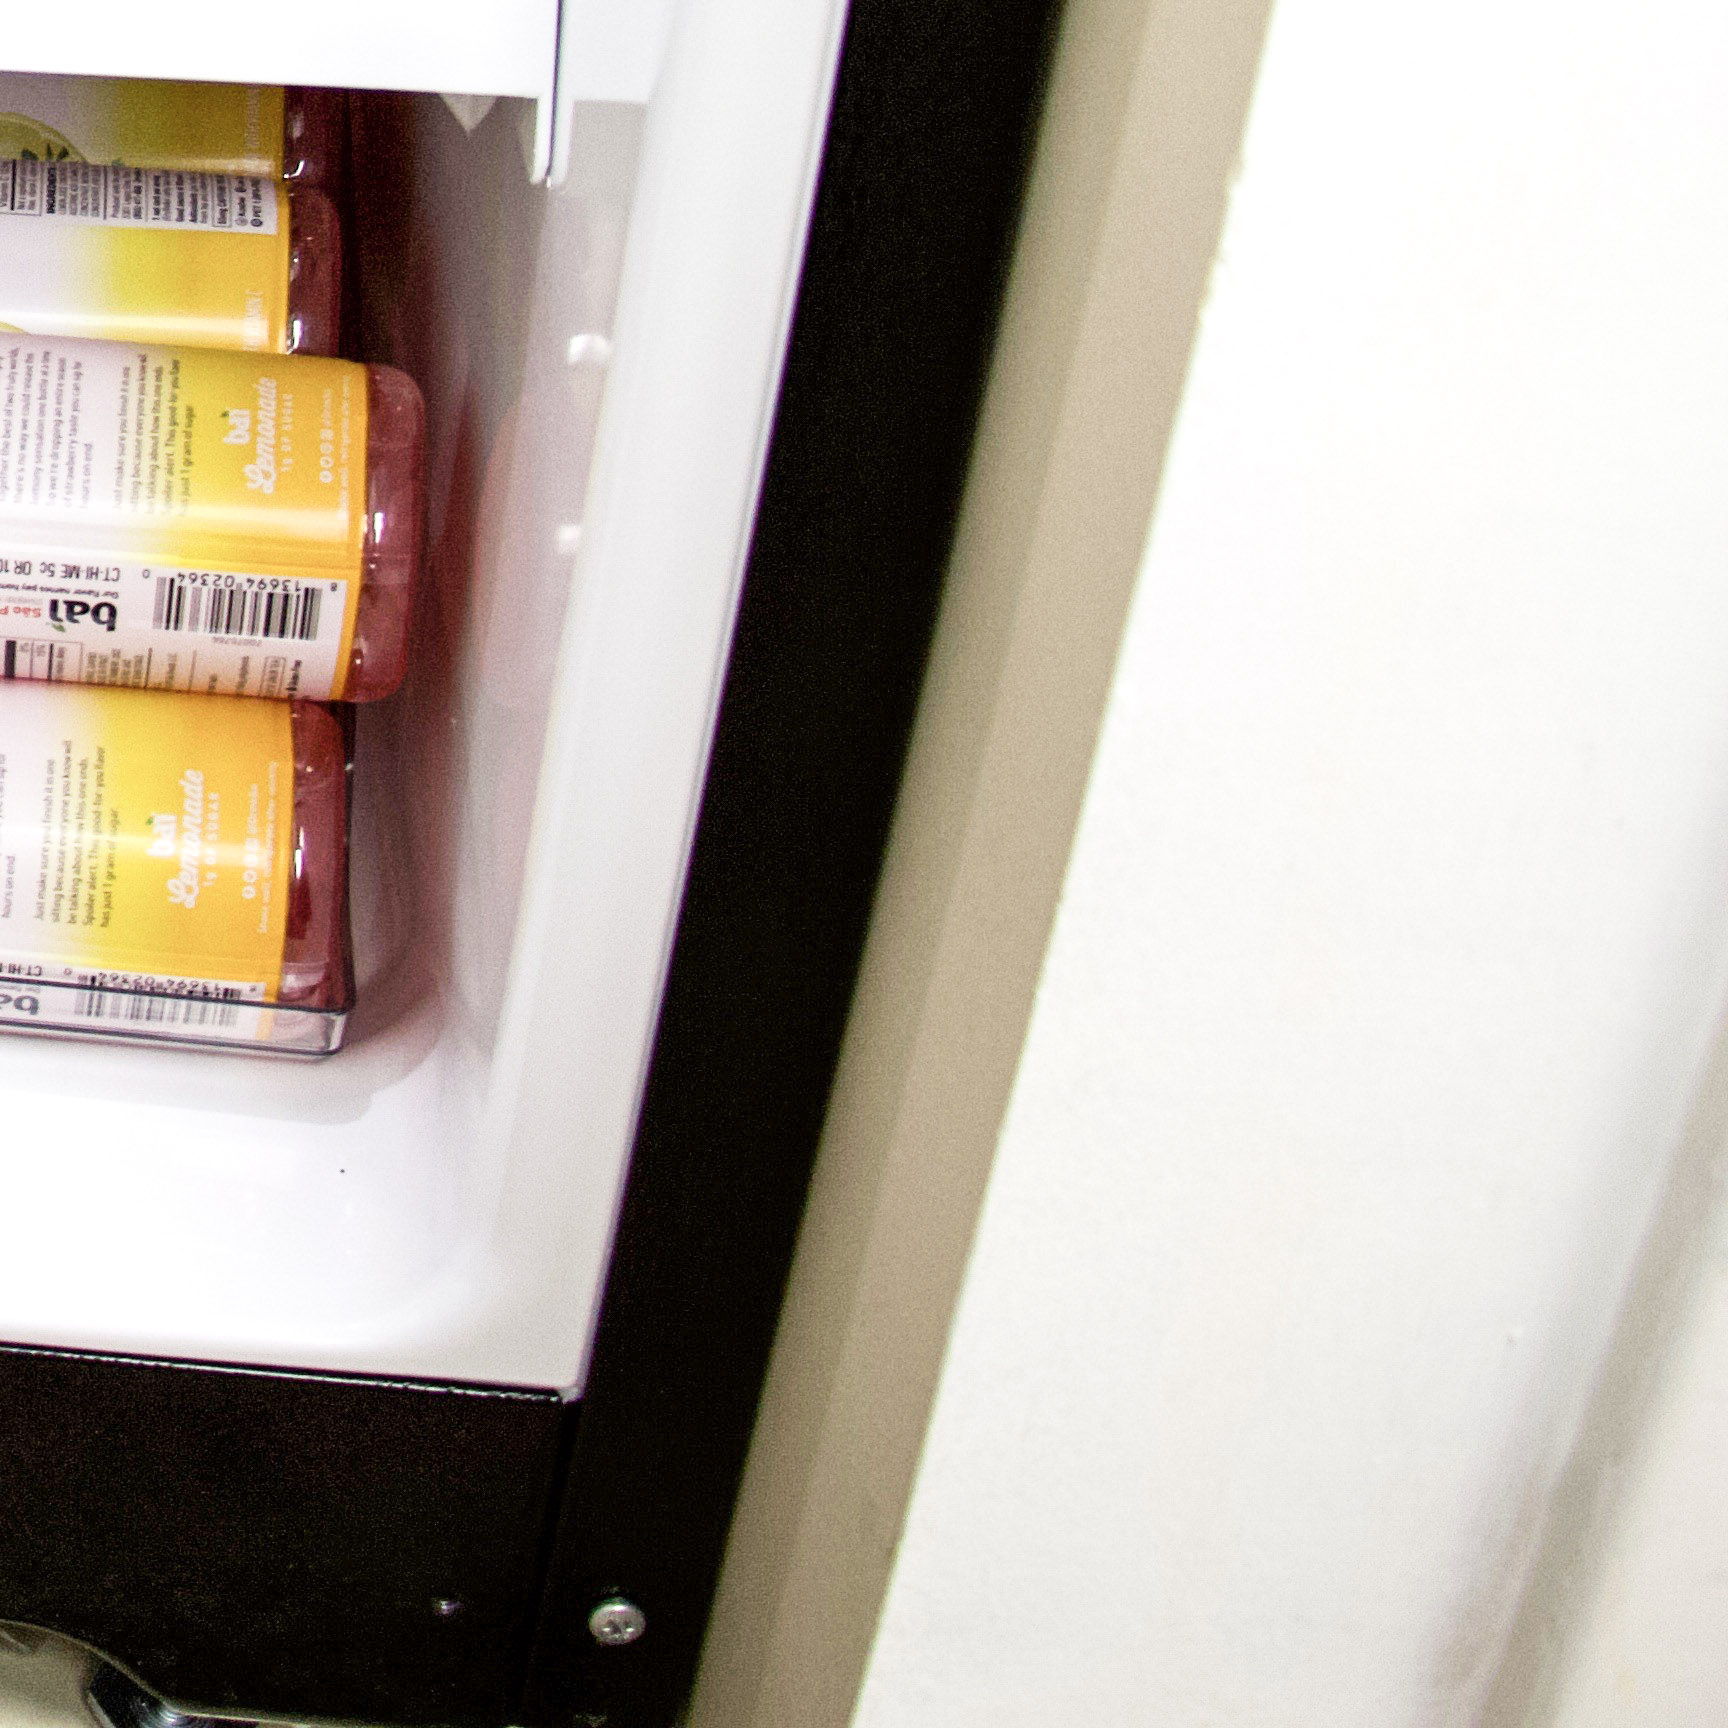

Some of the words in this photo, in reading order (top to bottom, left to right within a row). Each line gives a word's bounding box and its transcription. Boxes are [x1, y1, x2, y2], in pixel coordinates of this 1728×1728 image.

[243, 376, 277, 495] Lemonade
[13, 560, 33, 576] OR
[49, 598, 118, 632] bai
[146, 812, 177, 858] bai
[167, 768, 205, 910] Lemonade
